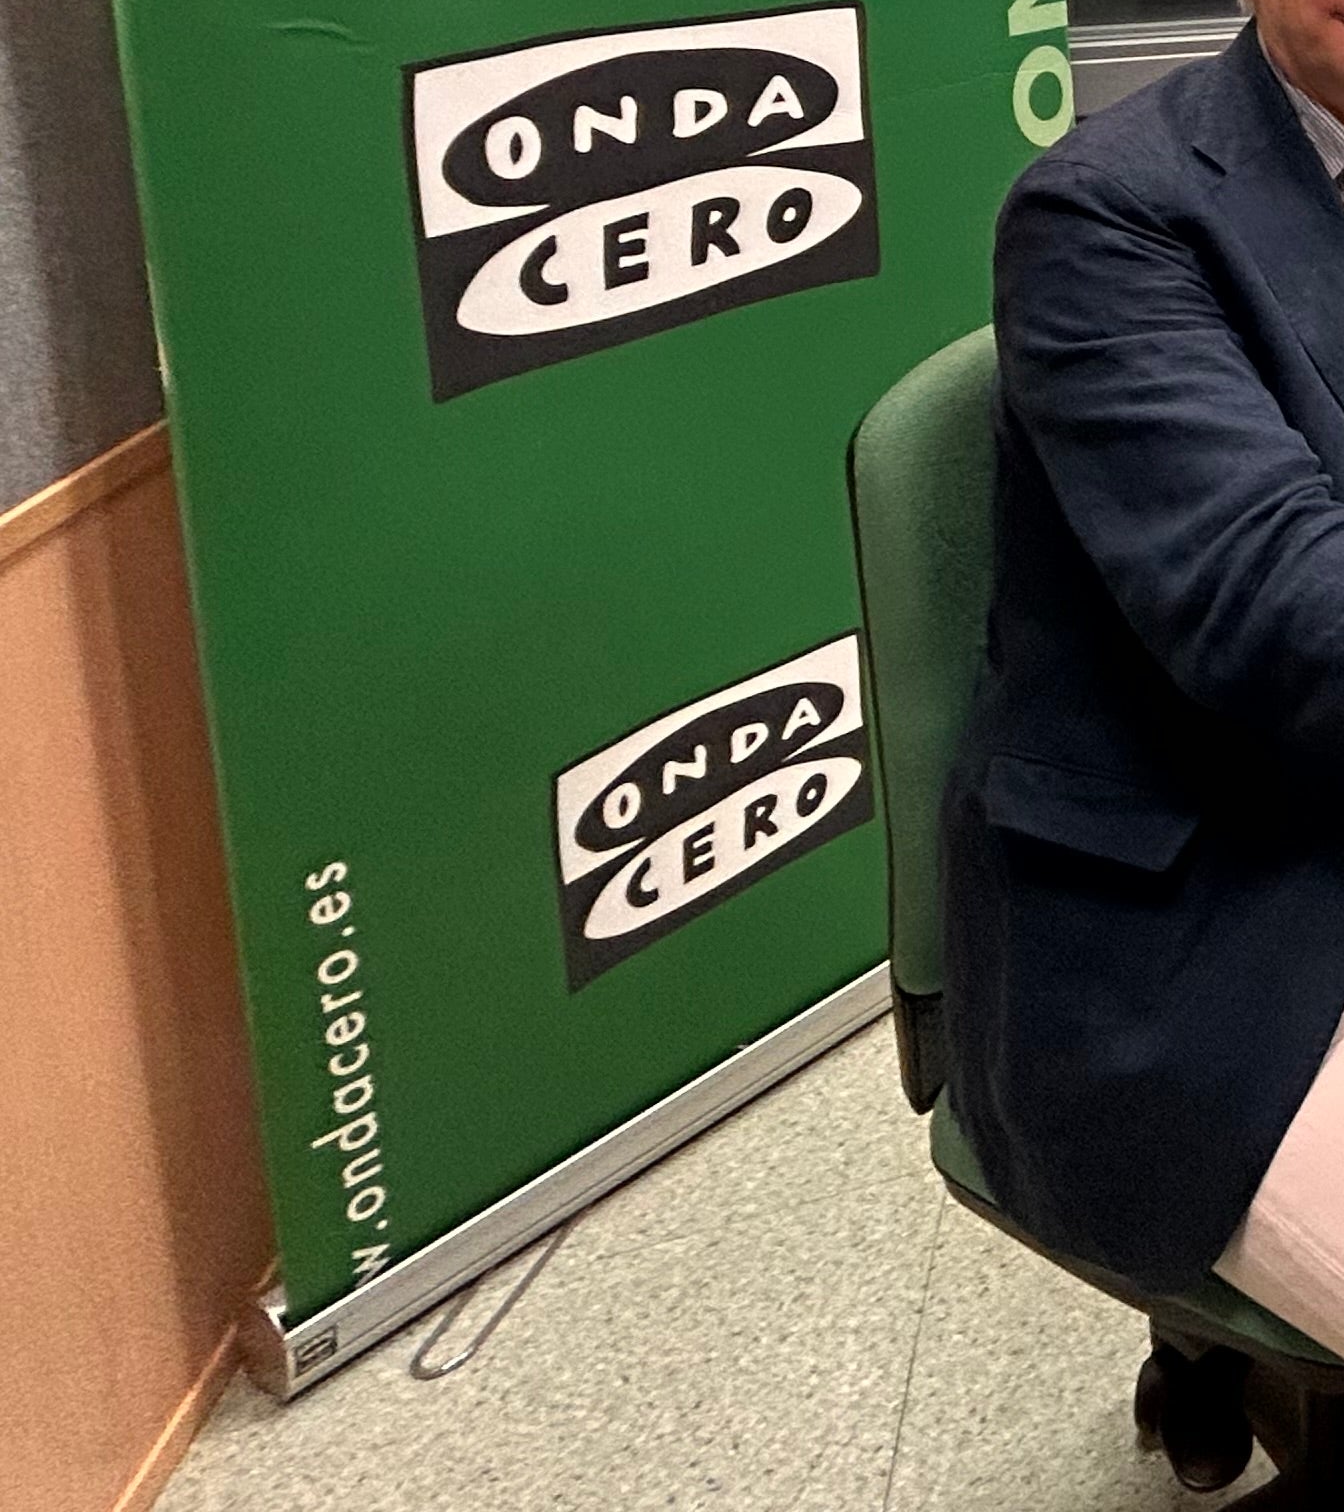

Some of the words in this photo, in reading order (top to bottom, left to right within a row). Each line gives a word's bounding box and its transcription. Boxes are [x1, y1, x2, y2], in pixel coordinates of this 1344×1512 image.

[484, 74, 805, 180] ONDA
[518, 187, 814, 306] CERO
[602, 695, 823, 830] ONDA
[625, 770, 829, 909] CERO
